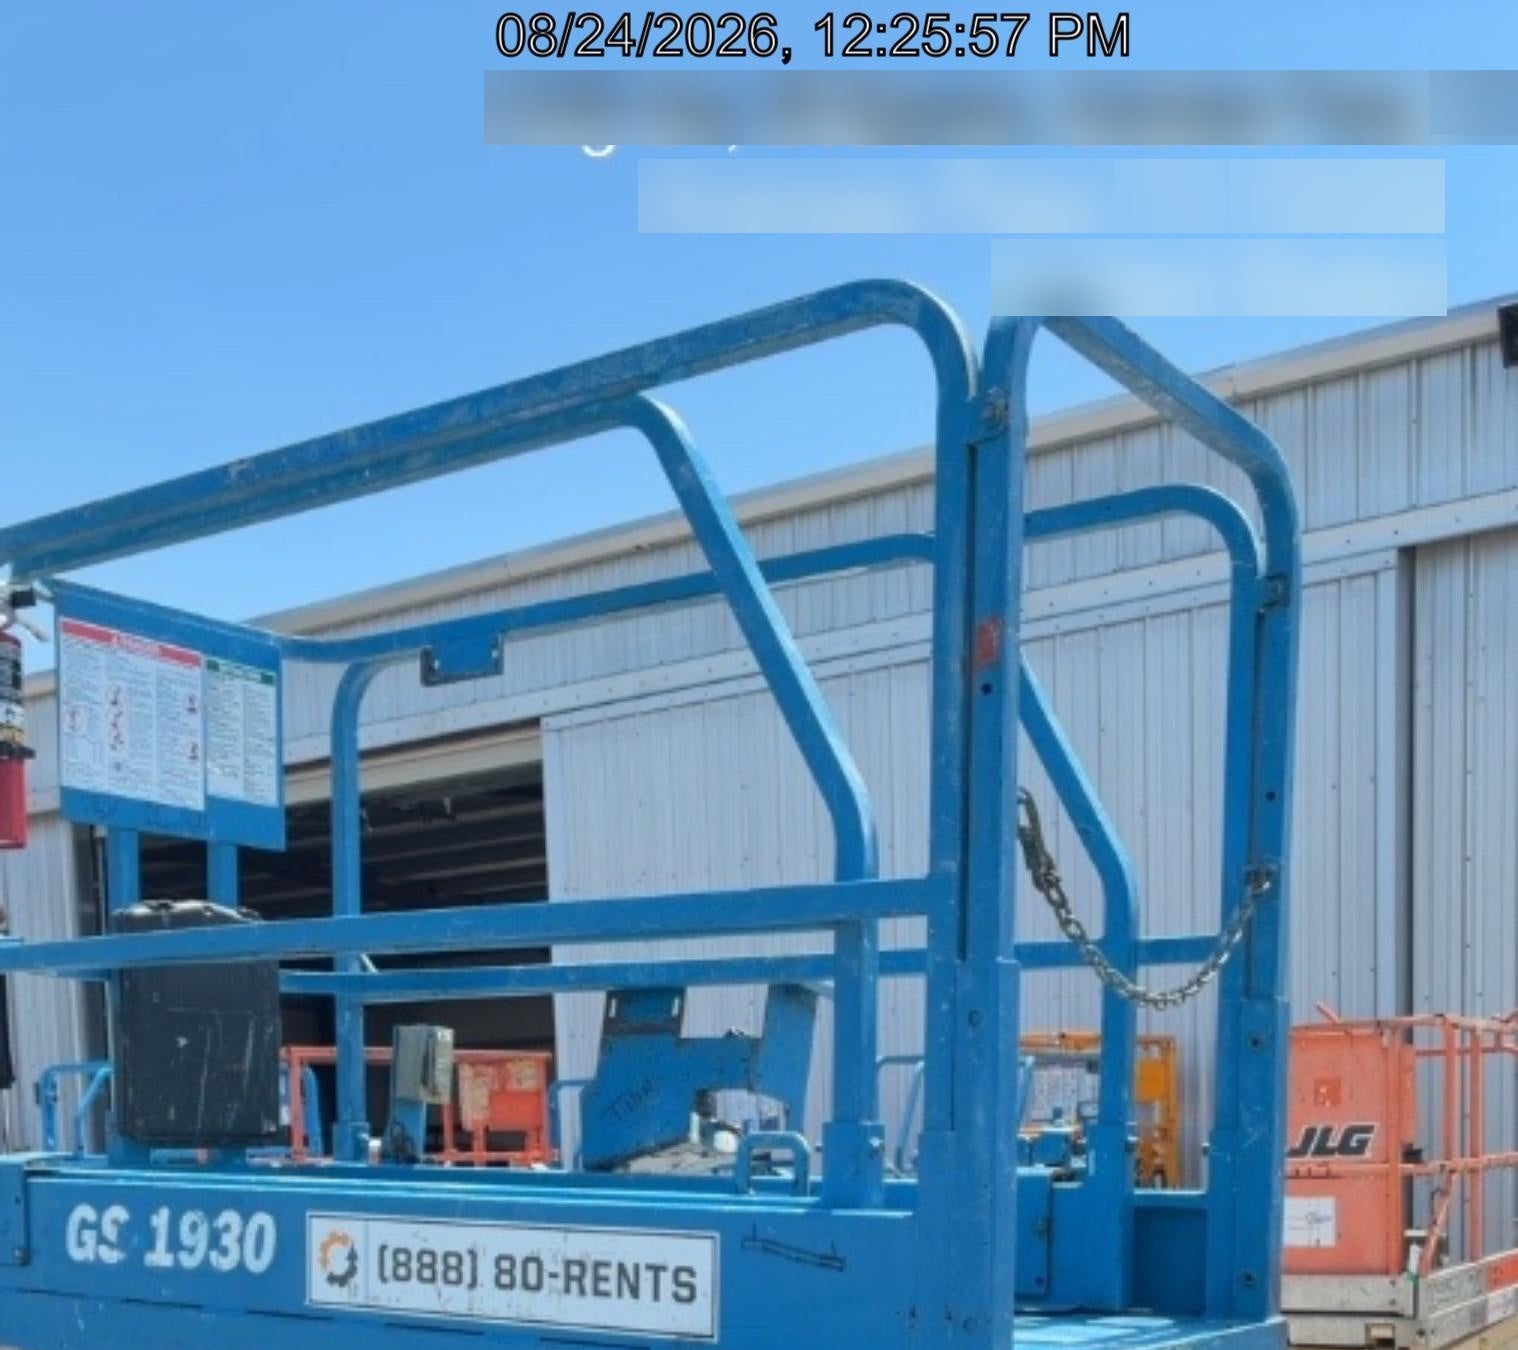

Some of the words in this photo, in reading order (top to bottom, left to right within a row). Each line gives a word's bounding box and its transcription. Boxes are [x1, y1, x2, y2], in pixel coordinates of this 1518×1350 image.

[1285, 1124, 1376, 1158] JLG
[65, 1202, 131, 1264] GS
[143, 1205, 278, 1275] 1930
[377, 1244, 478, 1291] (888)
[494, 1253, 698, 1304] 80-RENTS
